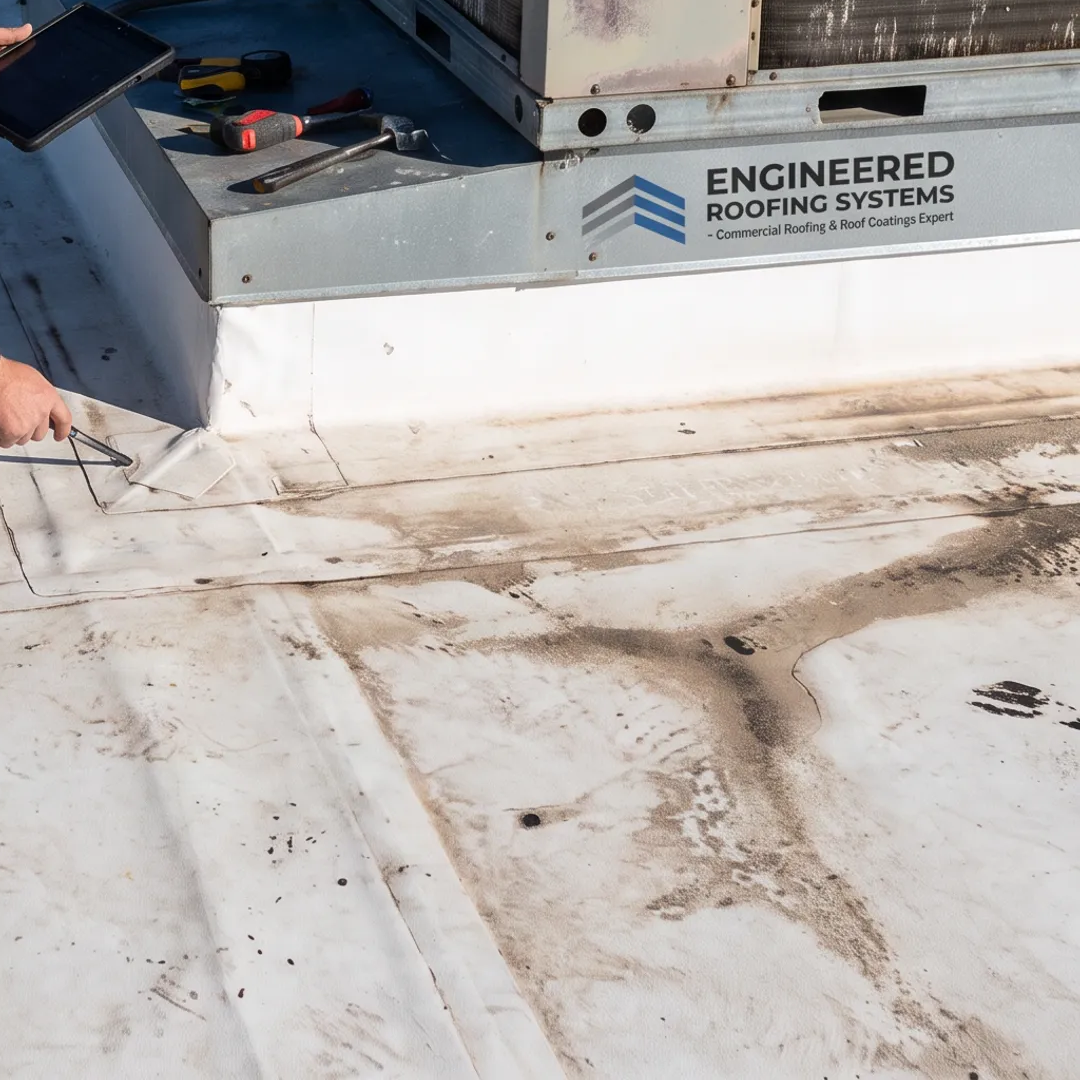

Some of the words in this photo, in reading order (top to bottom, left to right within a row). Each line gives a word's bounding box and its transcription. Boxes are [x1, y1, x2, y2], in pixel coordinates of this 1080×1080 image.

[706, 150, 955, 196] ENGINEERED
[706, 194, 828, 223] ROOFING
[835, 184, 955, 212] SYSTEMS
[715, 223, 782, 241] Commercial
[784, 221, 827, 235] Roofing
[828, 220, 838, 231] &
[840, 216, 866, 230] Roof
[867, 213, 917, 229] Coatings
[918, 211, 954, 226] Expert
